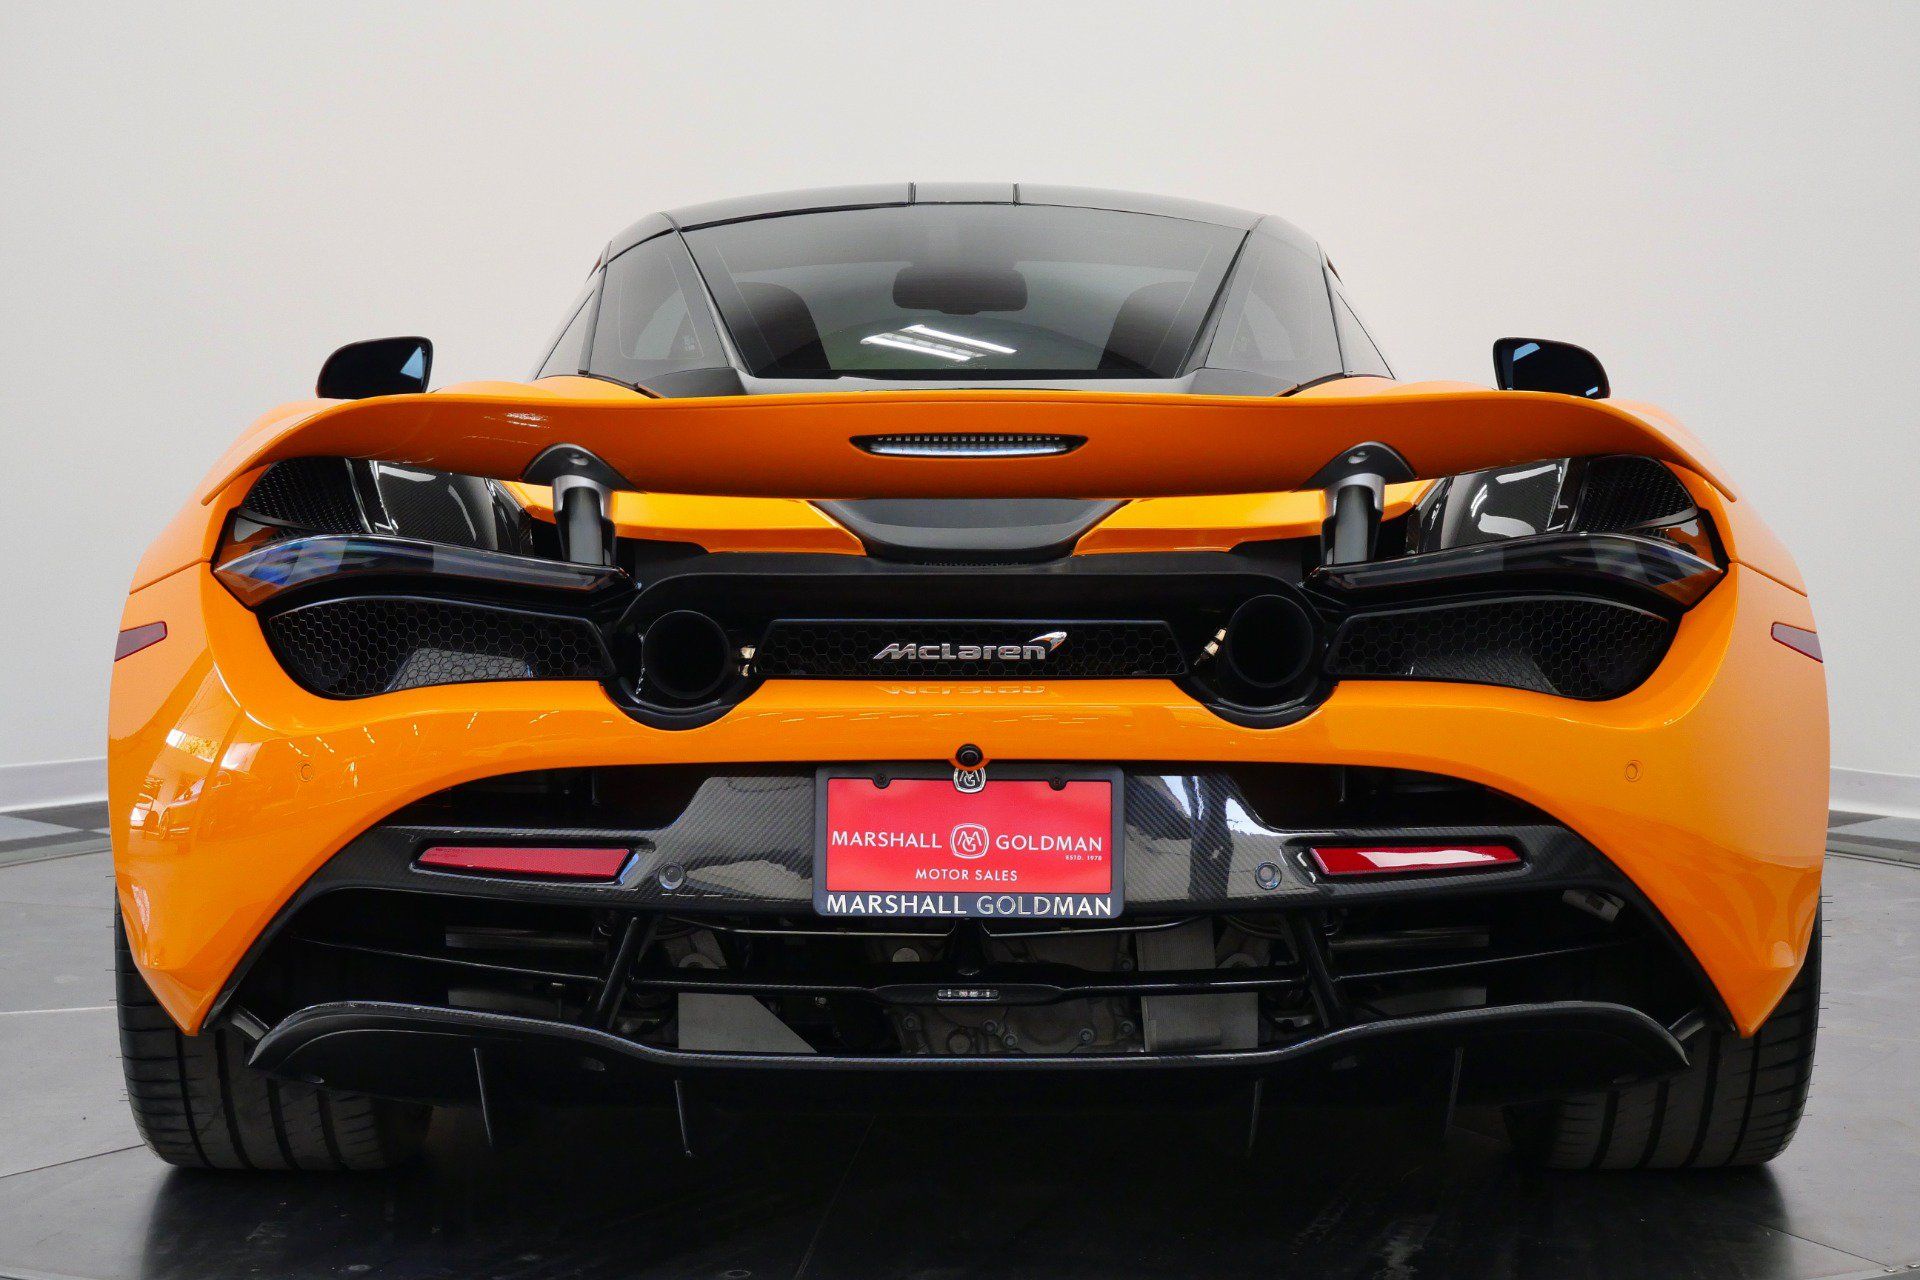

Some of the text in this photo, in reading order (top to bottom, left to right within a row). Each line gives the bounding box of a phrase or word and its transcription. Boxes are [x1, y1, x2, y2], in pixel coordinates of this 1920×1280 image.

[873, 643, 1046, 661] McLaren
[831, 830, 943, 849] MARSHALL
[995, 834, 1103, 852] GOLDMAN
[915, 867, 1018, 882] MOTOR SALES
[826, 893, 1112, 917] MARSHALL GOLDMAN
